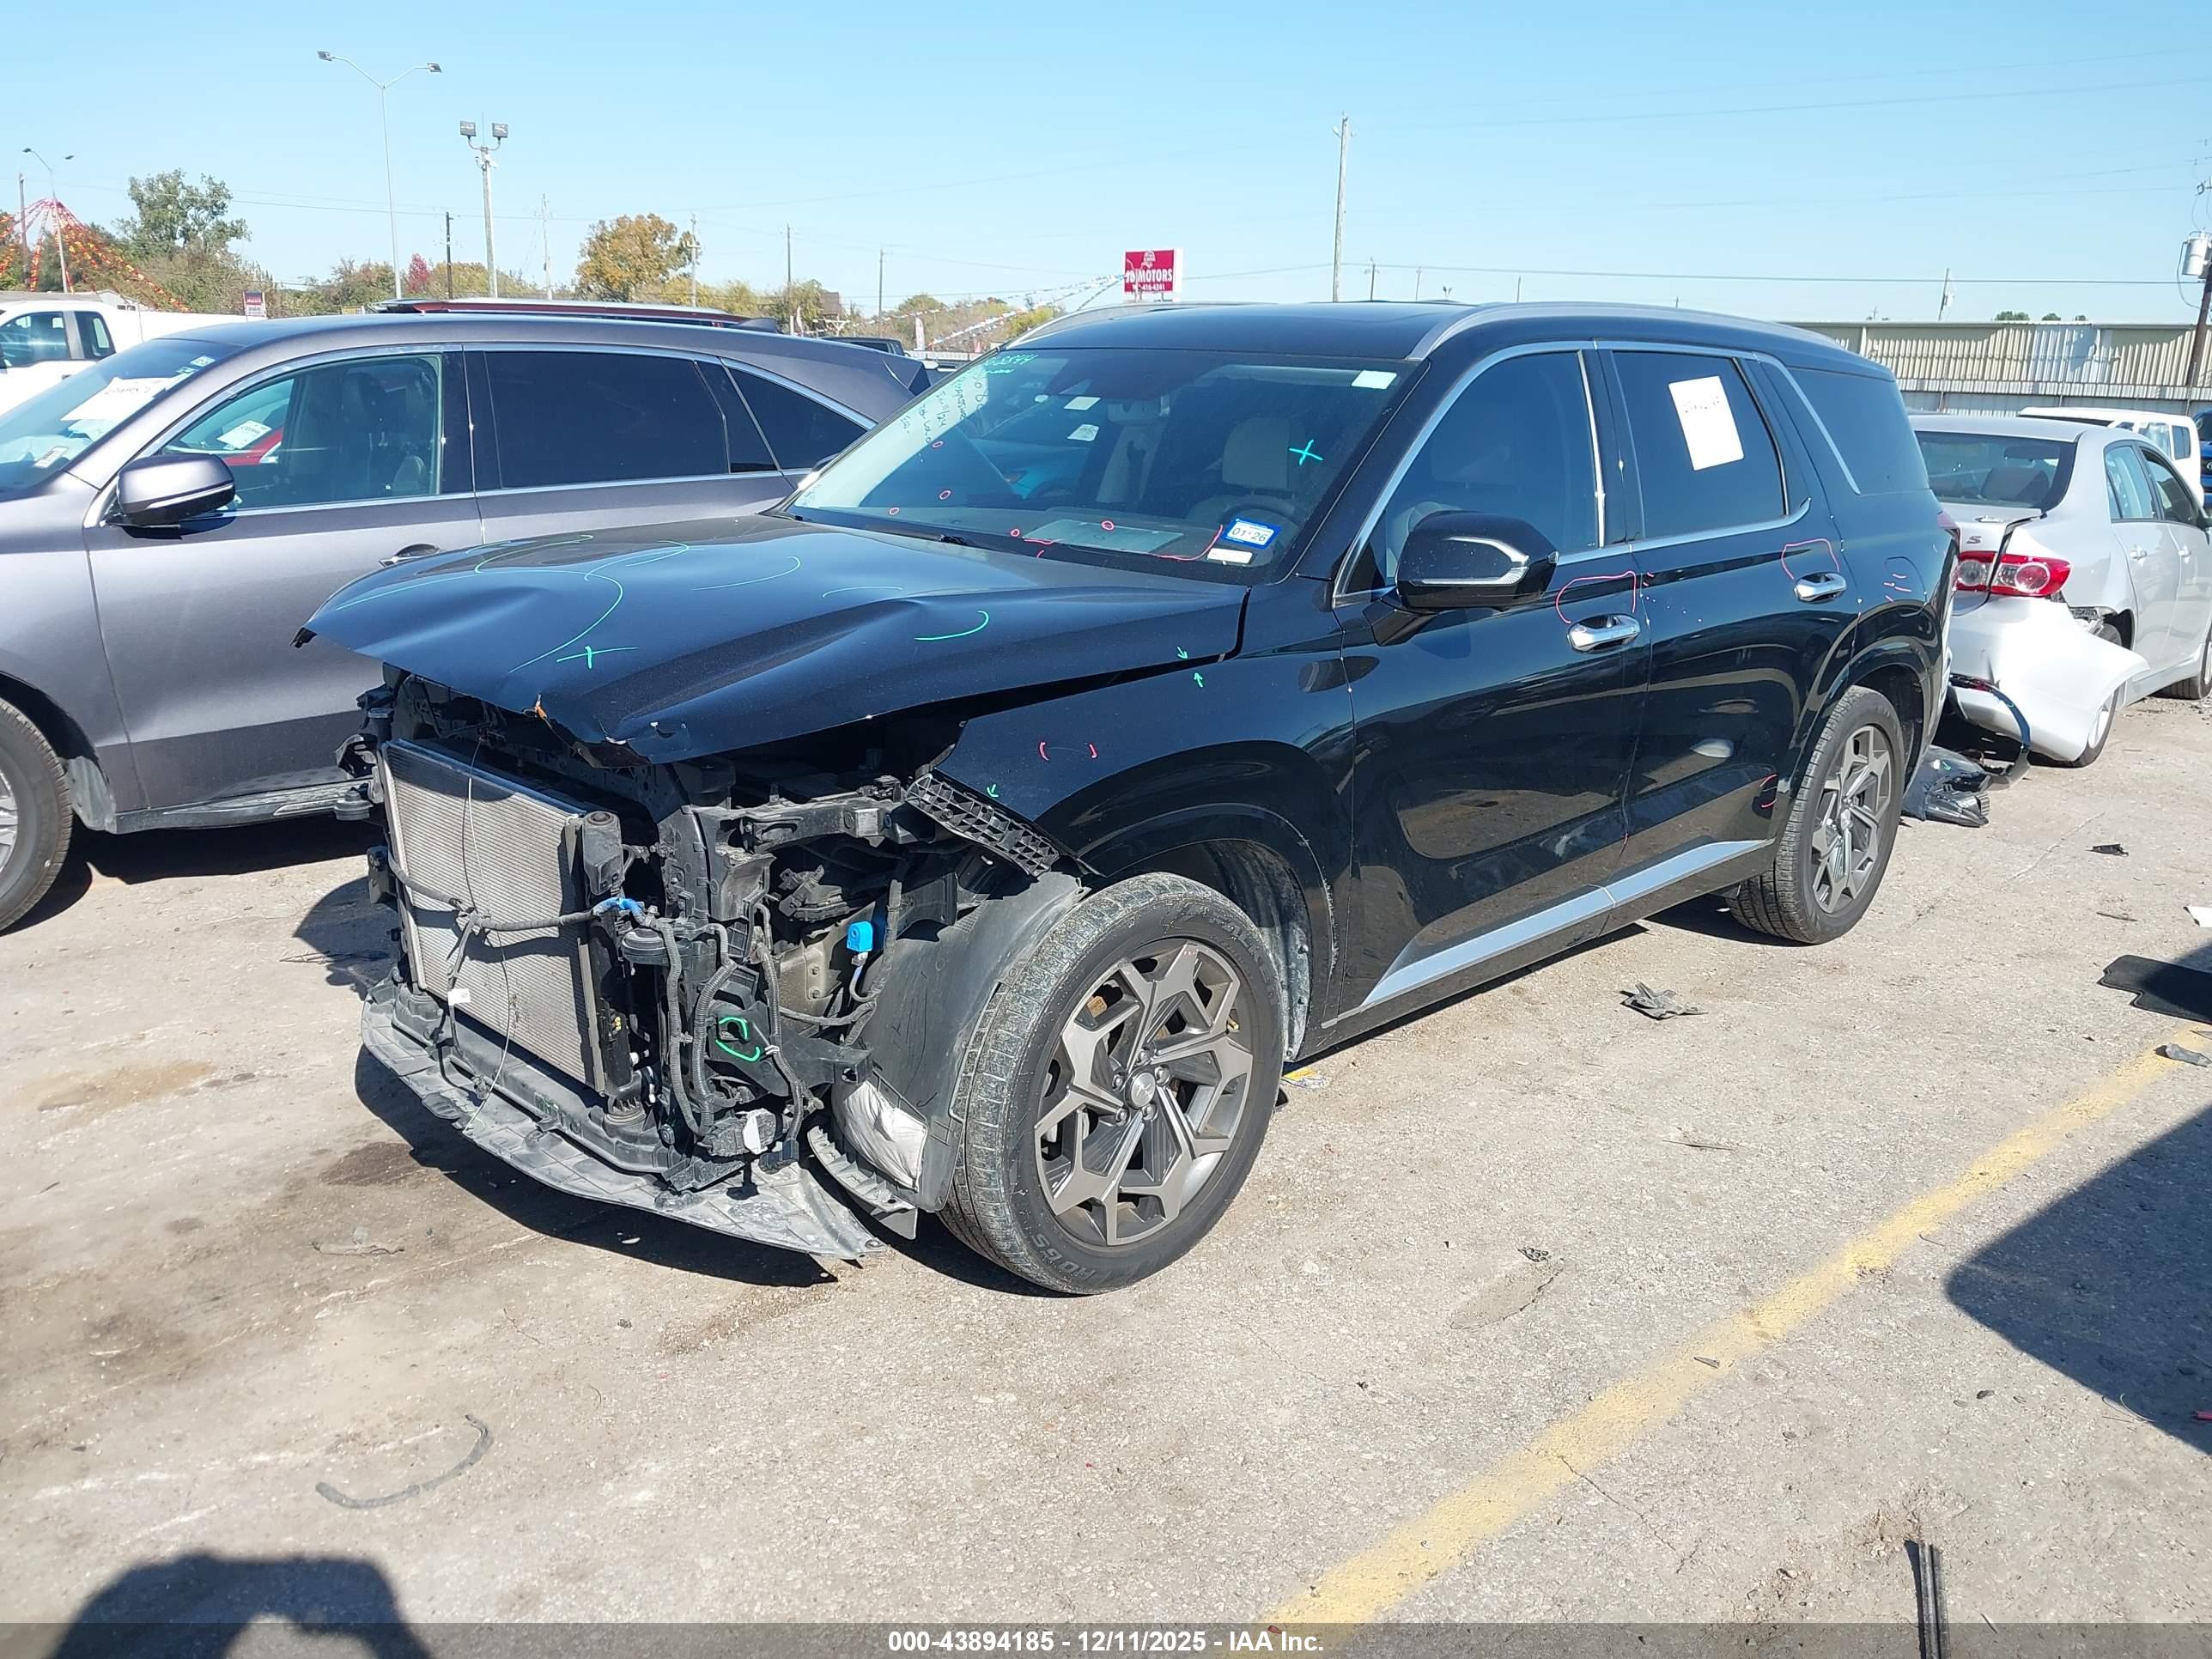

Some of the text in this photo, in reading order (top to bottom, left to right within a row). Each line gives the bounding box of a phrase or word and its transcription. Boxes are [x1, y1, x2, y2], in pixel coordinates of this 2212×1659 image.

[1138, 268, 1173, 283] MOTORS
[1231, 527, 1268, 542] 01 26
[1966, 535, 1982, 544] S
